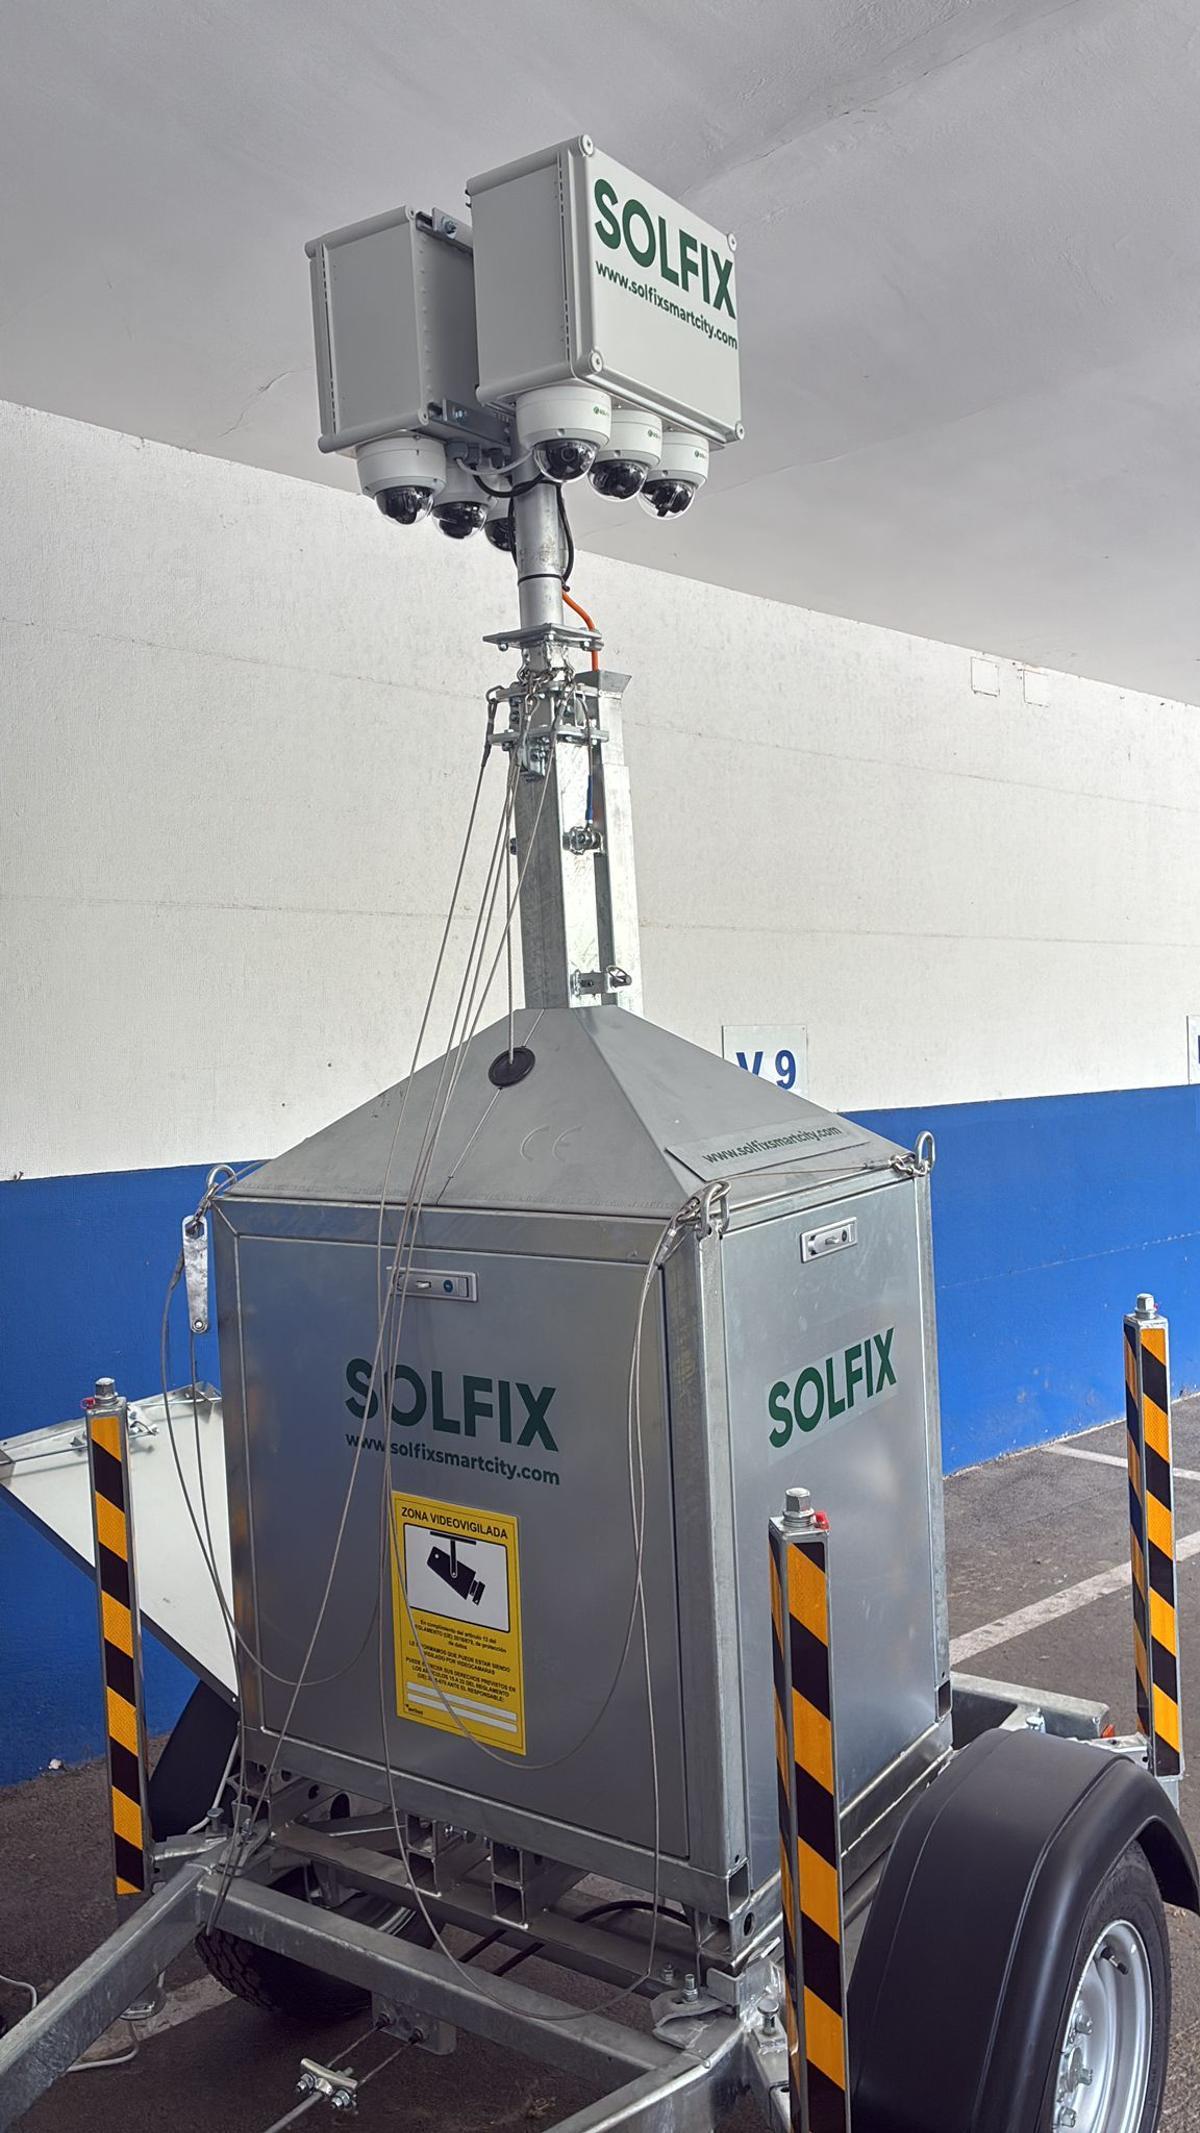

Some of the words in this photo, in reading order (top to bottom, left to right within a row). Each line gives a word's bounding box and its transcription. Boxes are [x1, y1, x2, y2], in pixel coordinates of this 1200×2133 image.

[594, 178, 737, 321] SOLFIX
[595, 260, 738, 350] www.solfixsmartcity.com
[775, 1050, 797, 1090] 9
[702, 1126, 843, 1164] www.solfixsmartcity.com
[345, 1358, 559, 1453] SOLFIX
[768, 1327, 897, 1448] SOLFIX
[345, 1433, 561, 1486] wwwsolfixsmartcity.com
[401, 1506, 429, 1522] ZONA
[429, 1512, 509, 1540] VIDEOVIGILADA
